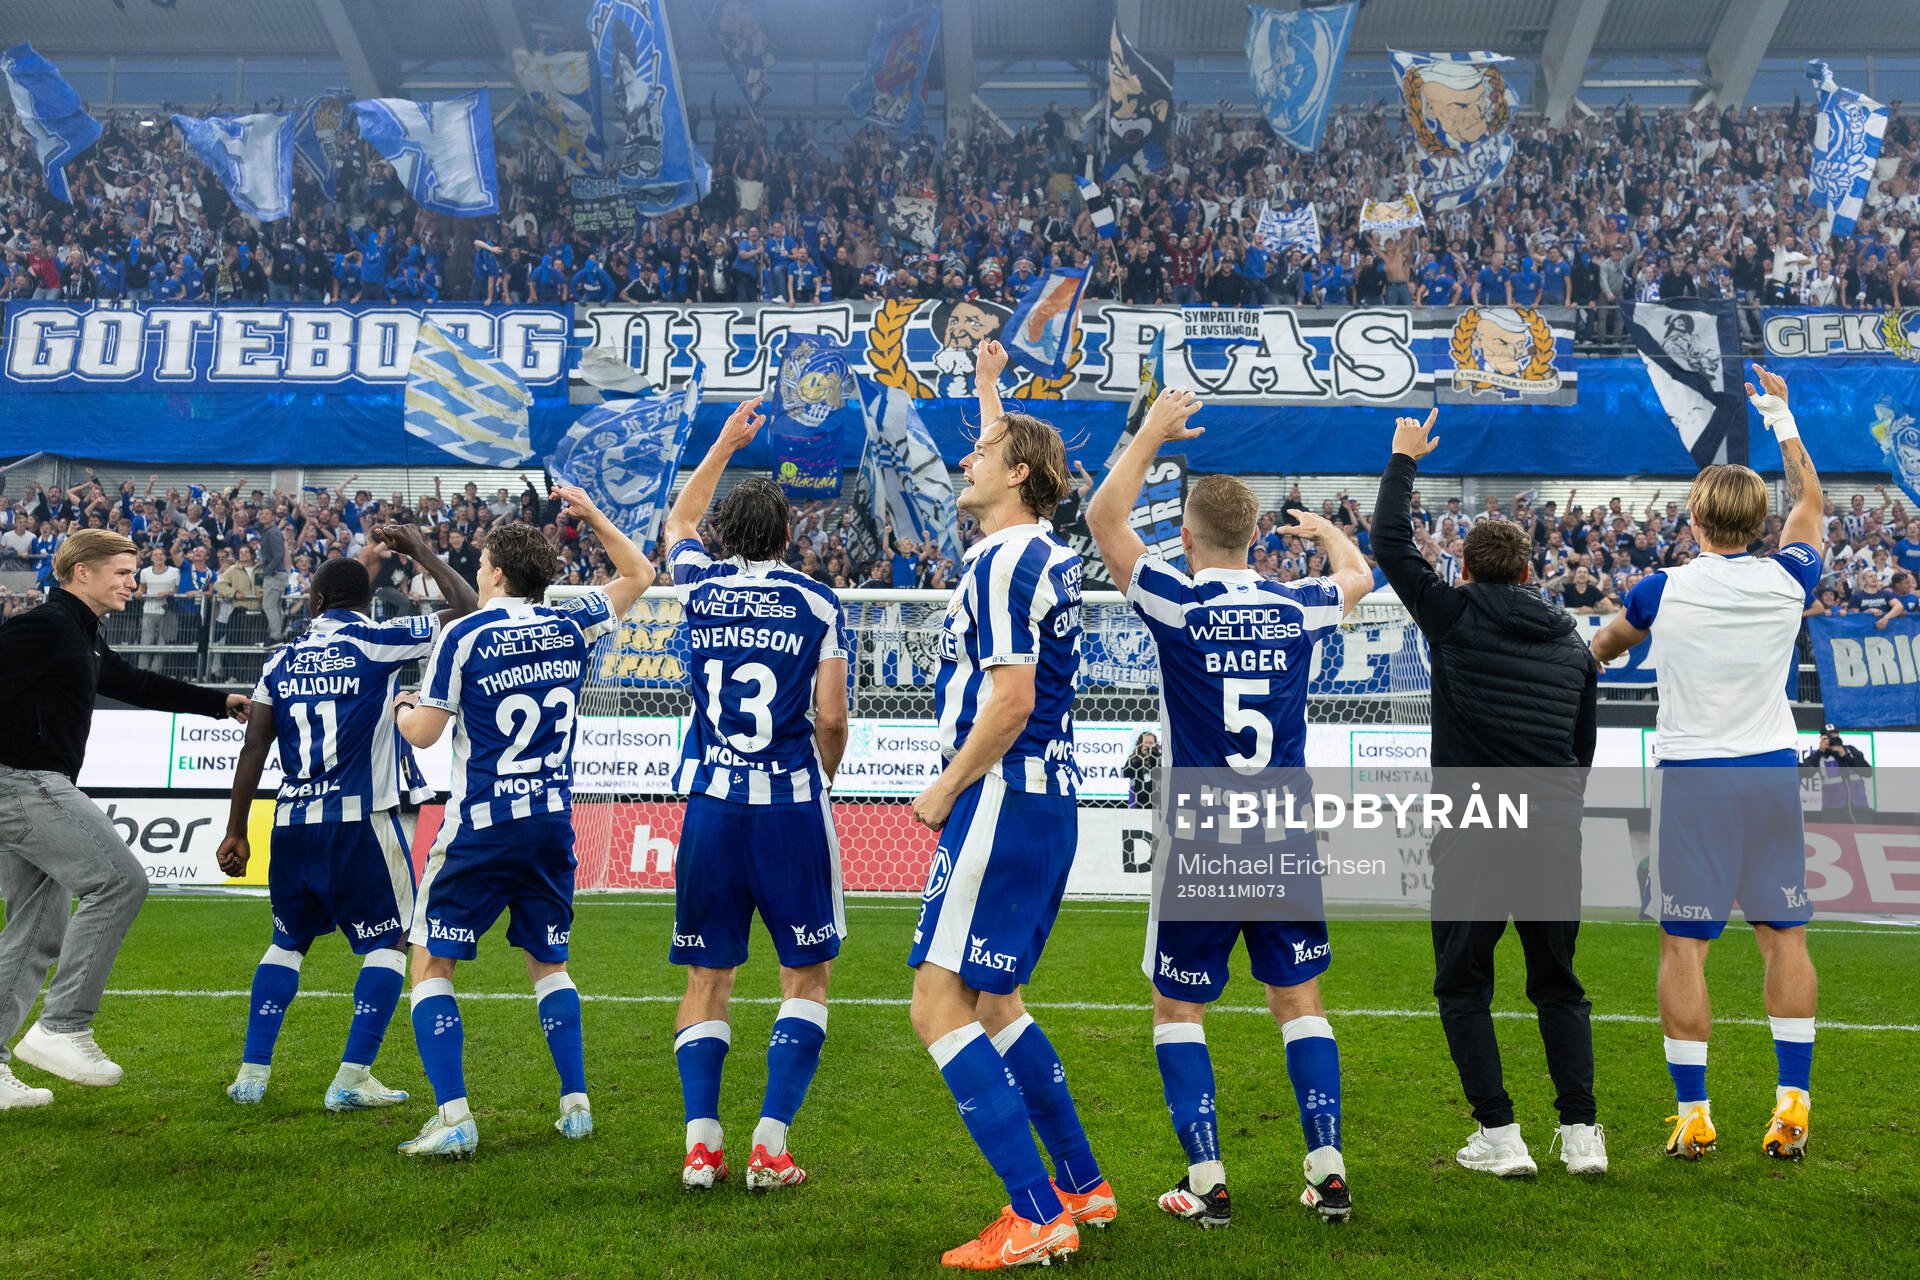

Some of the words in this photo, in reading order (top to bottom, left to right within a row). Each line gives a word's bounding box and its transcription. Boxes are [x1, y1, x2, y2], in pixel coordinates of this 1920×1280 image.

[1184, 310, 1235, 323] SYMPATI
[1238, 310, 1260, 324] FÖR
[1185, 325, 1199, 336] DE
[1200, 324, 1259, 337] AVSTÄNGDA
[1764, 314, 1886, 357] GFK
[707, 588, 780, 604] NORDIC
[692, 600, 797, 619] WELLNESS
[1208, 608, 1281, 626] NORDIC
[492, 623, 560, 644] NORDIC
[690, 626, 804, 656] SVENSSON
[1189, 622, 1301, 642] WELLNESS
[477, 634, 575, 661] WELLNESS
[992, 655, 1008, 663] IFK
[1024, 655, 1037, 663] IFK
[1205, 649, 1288, 673] BAGER
[477, 660, 582, 696] THORDARSON
[703, 658, 778, 753] 13
[180, 725, 245, 742] Larsso
[495, 686, 576, 776] 23
[1222, 677, 1274, 776] 5
[289, 699, 338, 780] 11
[582, 729, 671, 747] Karlsson
[877, 736, 940, 752] Karlsso
[1075, 742, 1123, 754] rsson
[1358, 743, 1428, 758] Larsson
[644, 761, 670, 776] AB
[1662, 901, 1713, 920] RASTA
[357, 917, 401, 939] RASTA
[430, 924, 476, 944] RASTA
[547, 930, 569, 945] RAST
[795, 922, 837, 947] RASTA
[967, 946, 1017, 973] RAST
[1158, 961, 1212, 986] RASTA
